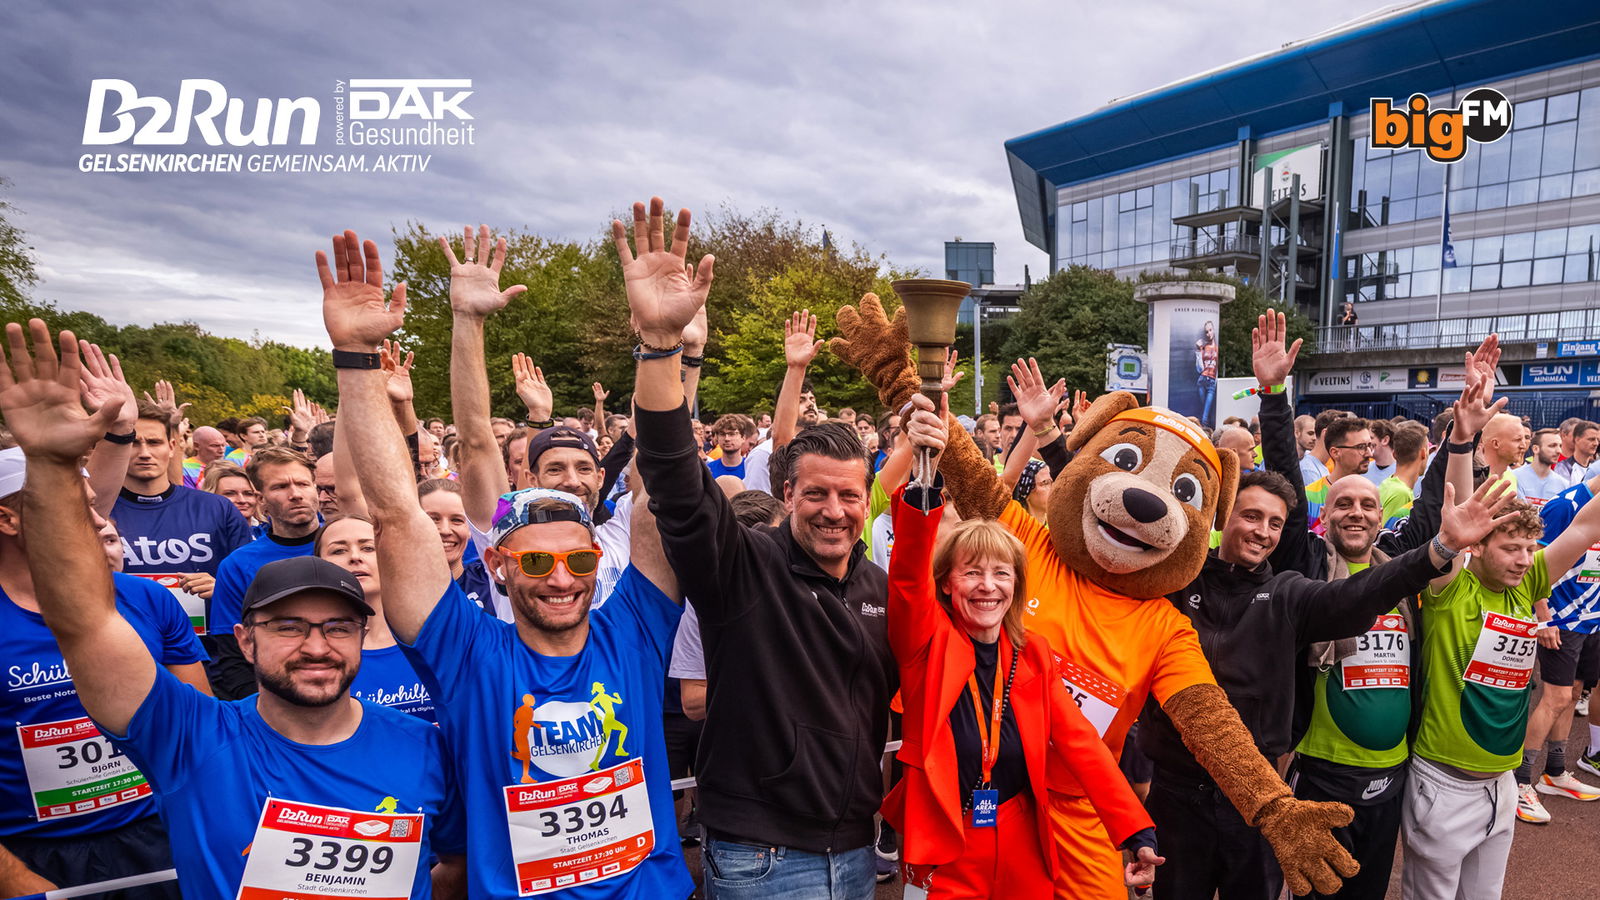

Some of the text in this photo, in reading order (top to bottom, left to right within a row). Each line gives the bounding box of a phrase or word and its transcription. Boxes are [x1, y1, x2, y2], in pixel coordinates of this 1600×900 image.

[1529, 365, 1573, 376] SUN
[1533, 375, 1567, 383] MINIMEAL
[1320, 375, 1350, 386] VELTINS
[1358, 633, 1404, 651] 3176
[1493, 635, 1536, 657] 3153
[8, 659, 72, 688] Schül
[24, 689, 77, 703] Beste Note
[35, 726, 73, 740] B2Run
[533, 710, 604, 747] TEAM
[531, 733, 607, 757] GELSENKIRCHEN
[71, 783, 111, 797] STARTZEIT
[112, 777, 132, 788] 17:30
[519, 788, 556, 802] B2Run
[279, 807, 323, 825] B2Run
[539, 794, 629, 838] 3394
[566, 828, 610, 845] THOMAS
[636, 836, 647, 848] D
[285, 837, 394, 874] 3399
[552, 855, 593, 869] STARTZEIT
[594, 849, 614, 861] 17:30
[614, 845, 628, 854] Uhr
[560, 845, 577, 854] Stadt
[305, 873, 366, 886] BENJAMIN
[297, 883, 368, 895] Stadt Gelsenkirchen
